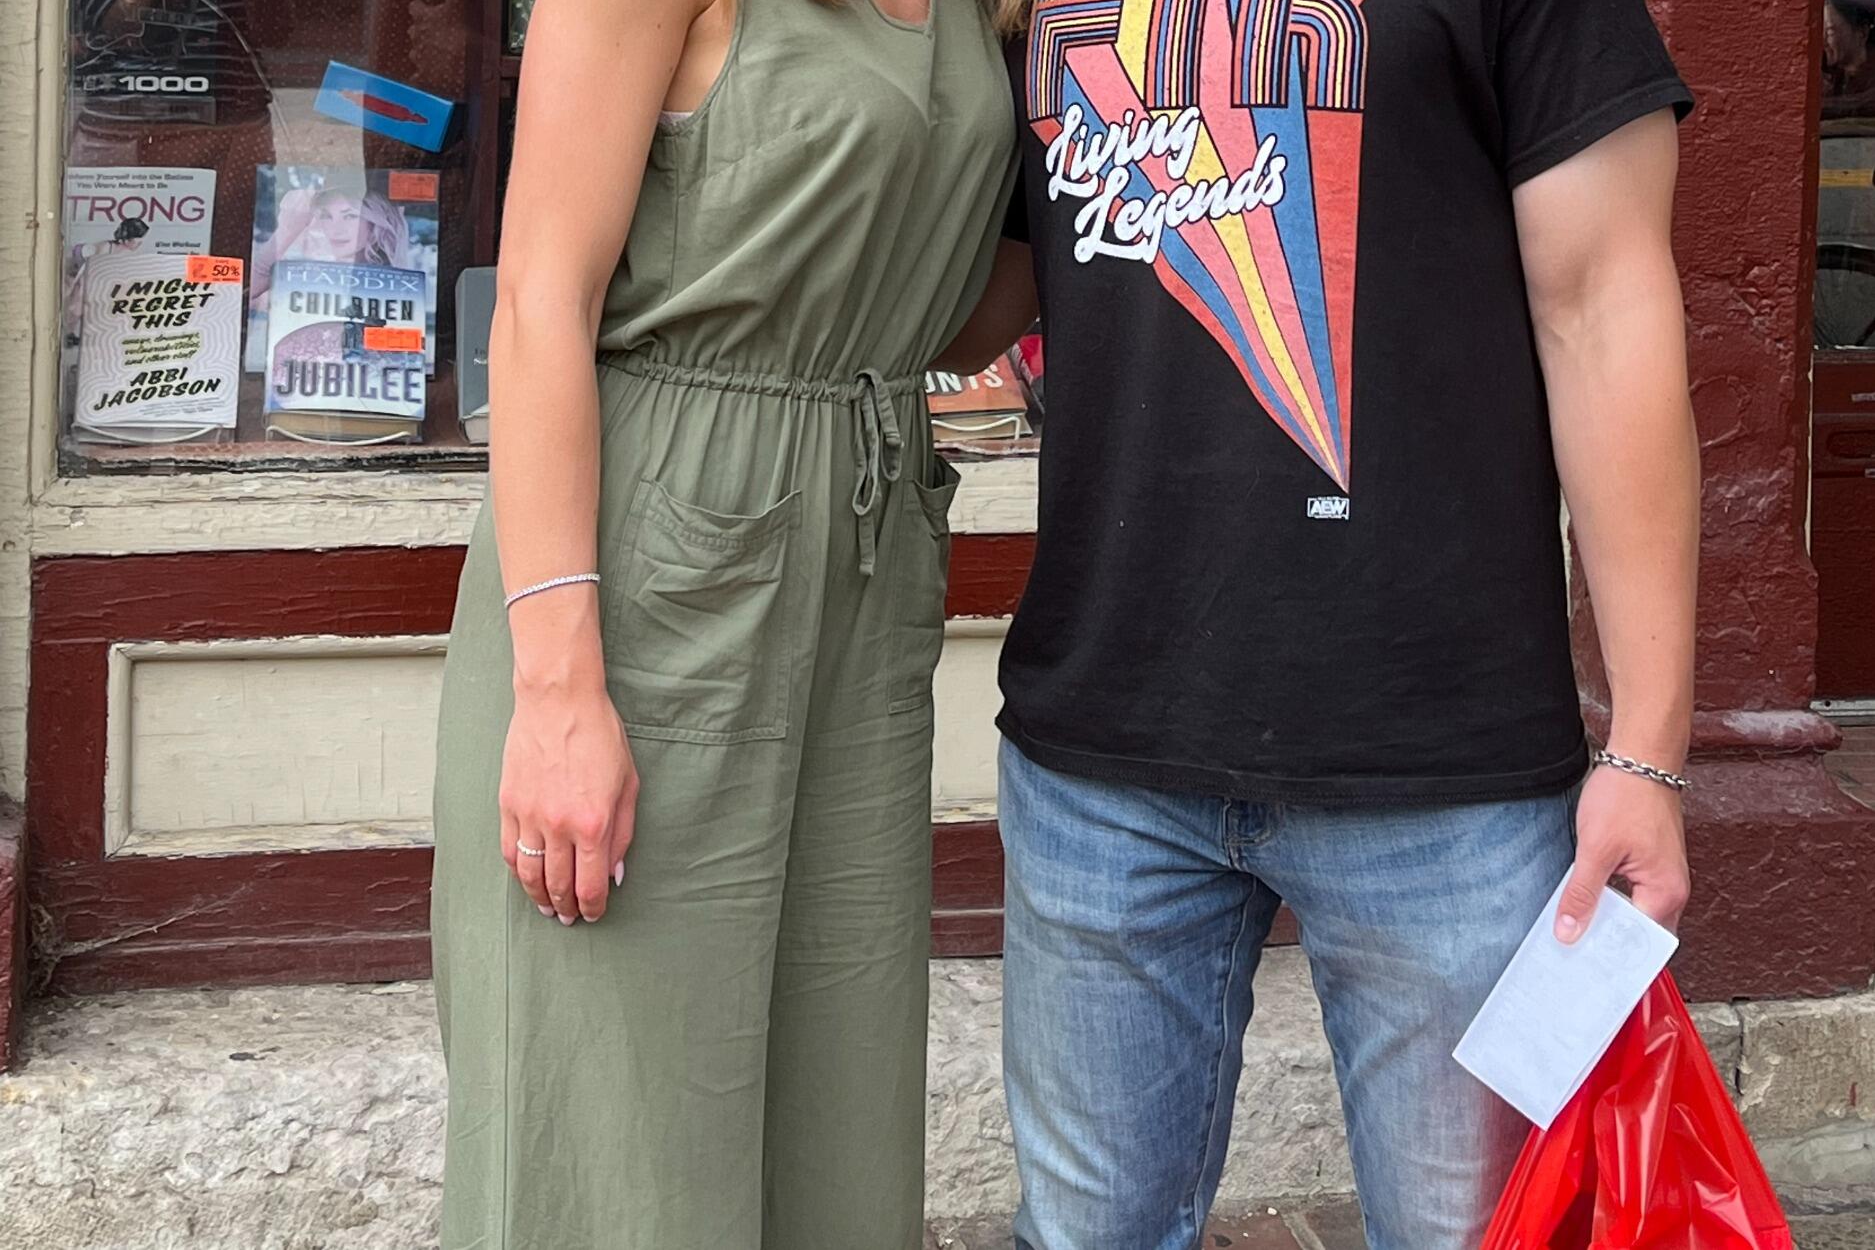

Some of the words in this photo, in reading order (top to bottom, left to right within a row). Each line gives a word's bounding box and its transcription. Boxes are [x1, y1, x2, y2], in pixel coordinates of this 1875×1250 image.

[119, 76, 209, 92] 1000
[1045, 103, 1200, 201] Living
[67, 195, 206, 223] TRONG
[1073, 133, 1287, 263] Legends
[110, 283, 122, 298] I
[286, 270, 420, 292] HADDIX
[112, 293, 215, 315] REGRET
[289, 291, 414, 322] CHILDREN
[131, 311, 192, 330] THIS
[130, 367, 189, 387] ABBI
[276, 359, 423, 404] JUBILEE
[93, 378, 221, 411] JACOBSON
[1310, 499, 1347, 516] AEW
